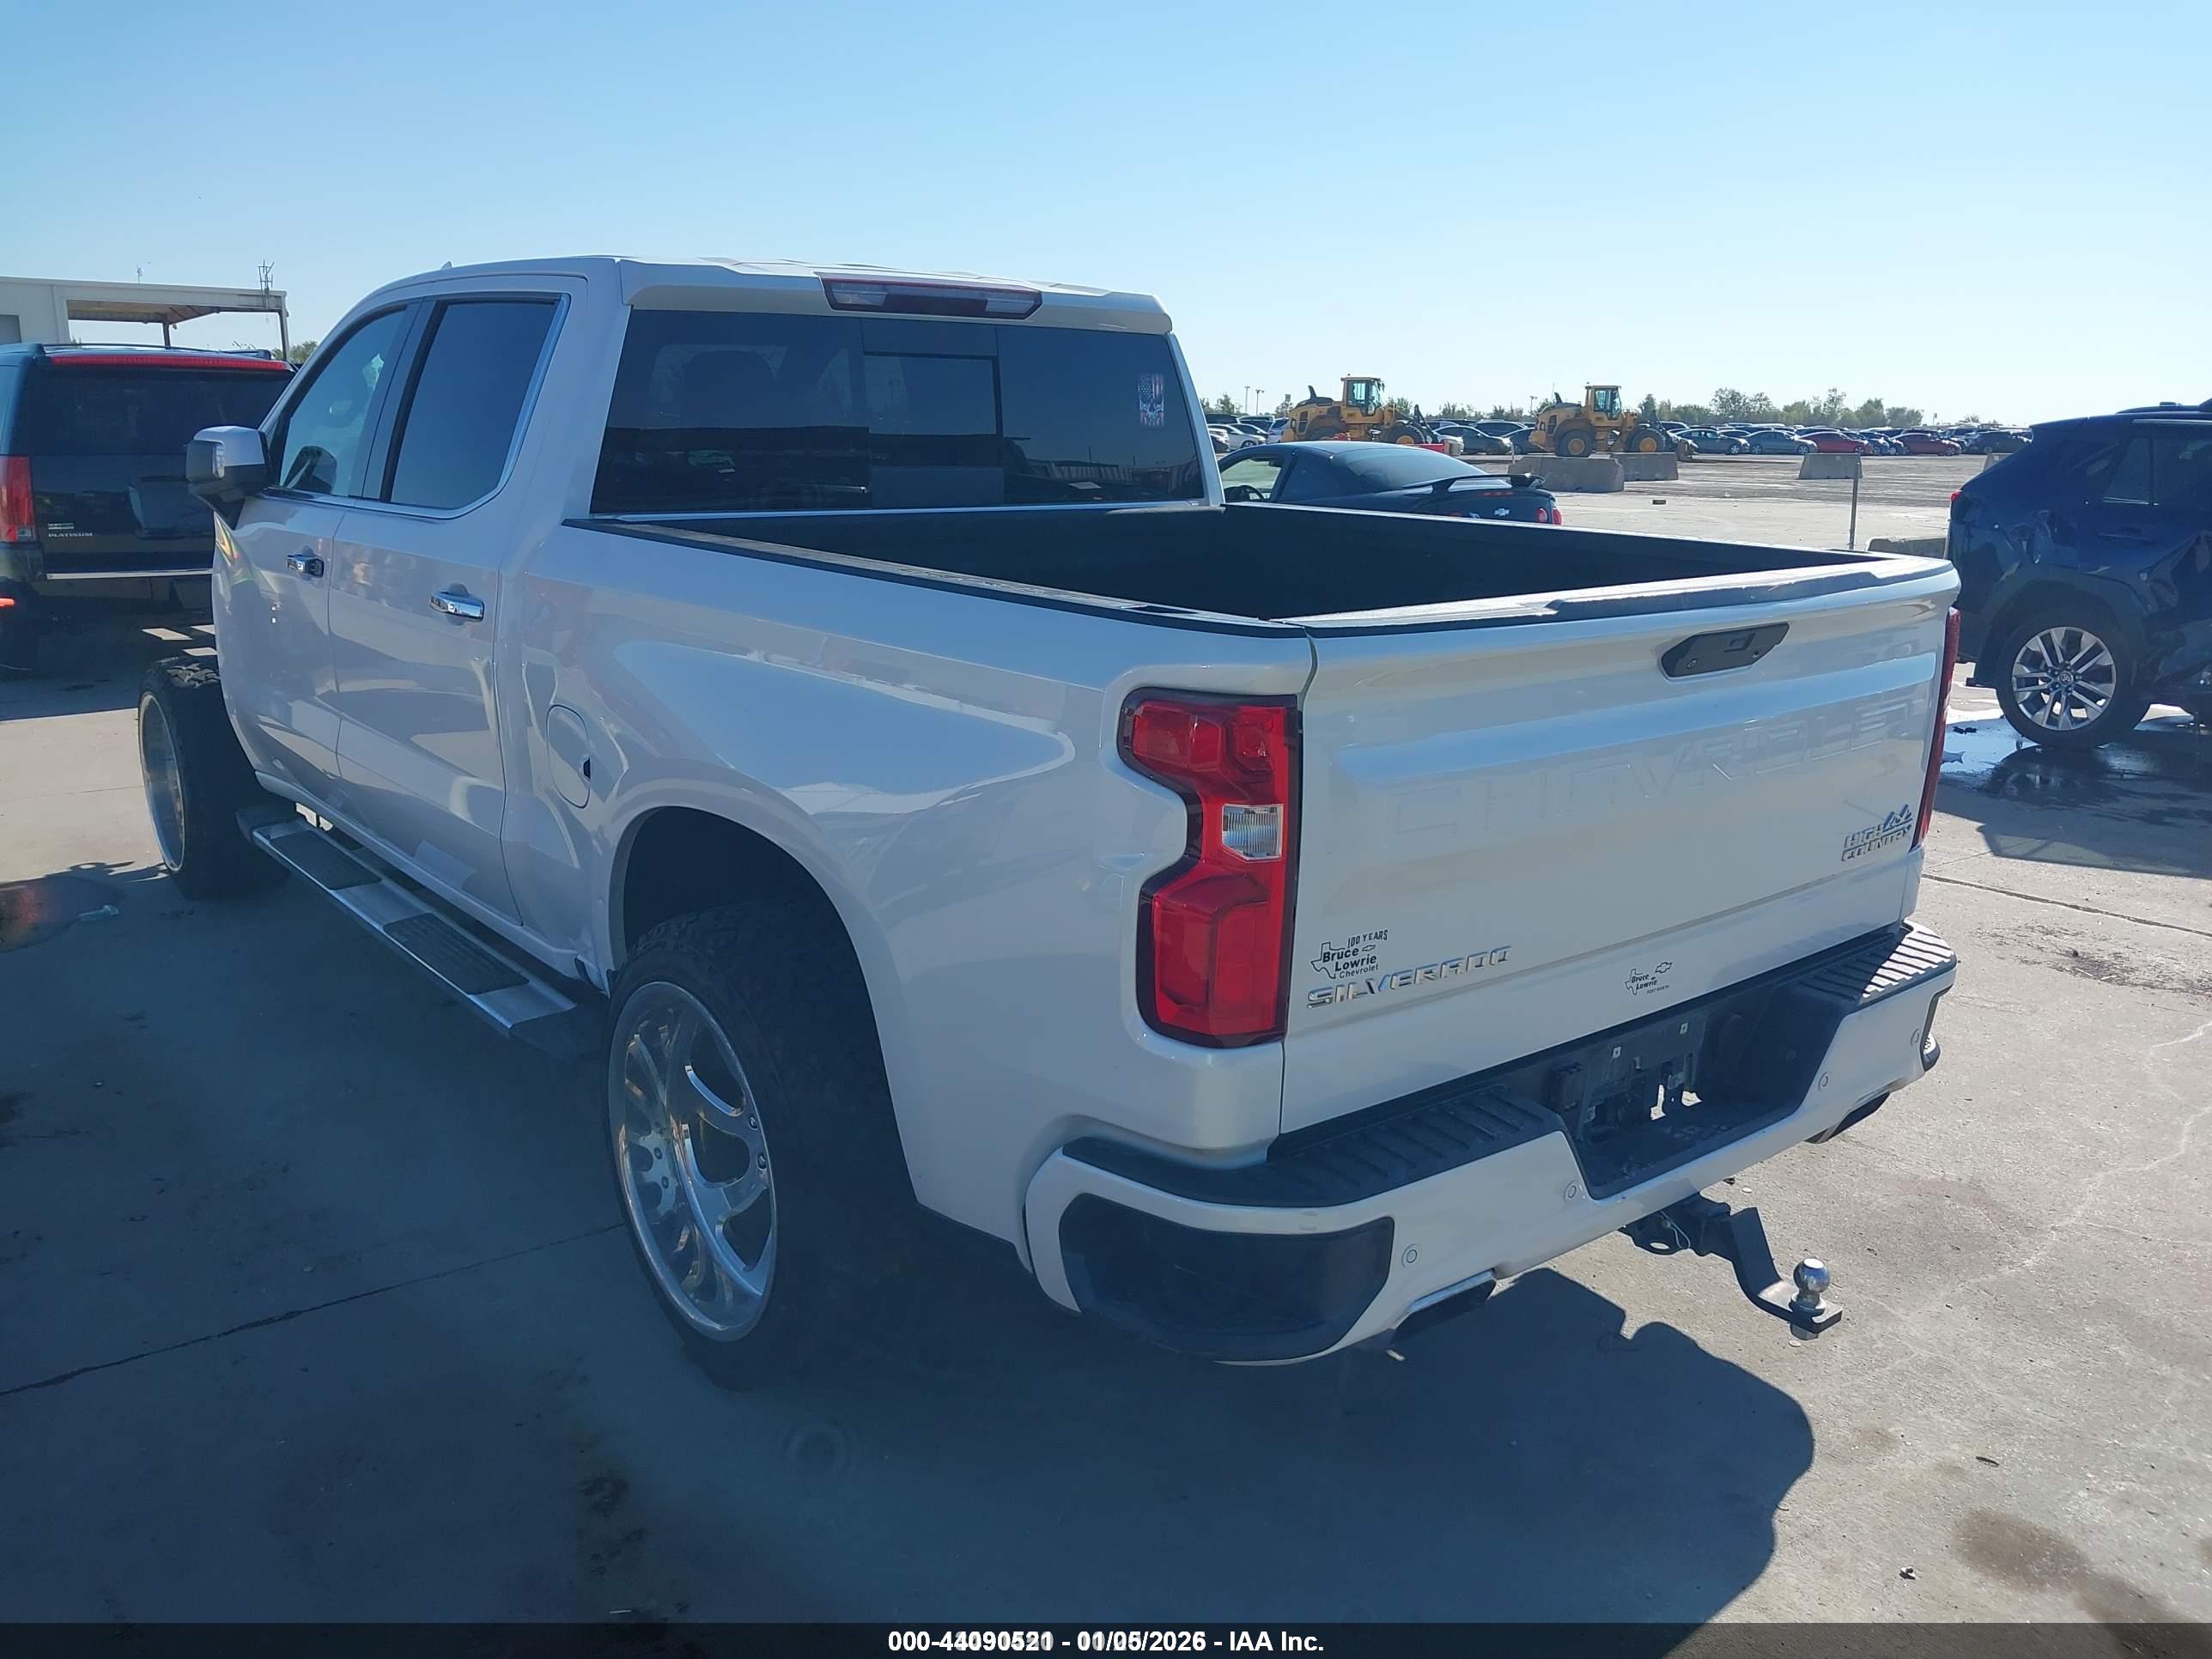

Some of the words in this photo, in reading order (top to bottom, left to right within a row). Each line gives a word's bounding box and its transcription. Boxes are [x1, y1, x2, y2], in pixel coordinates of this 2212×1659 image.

[1347, 935, 1361, 949] 100
[1362, 929, 1389, 942] YEARS
[1322, 947, 1359, 963] Bruce
[1334, 954, 1377, 972] Lowrie
[1307, 945, 1511, 1008] SILVERADO
[1339, 964, 1379, 979] Chevrolet
[1631, 974, 1650, 983] Bruce
[1636, 979, 1658, 990] Lowrie
